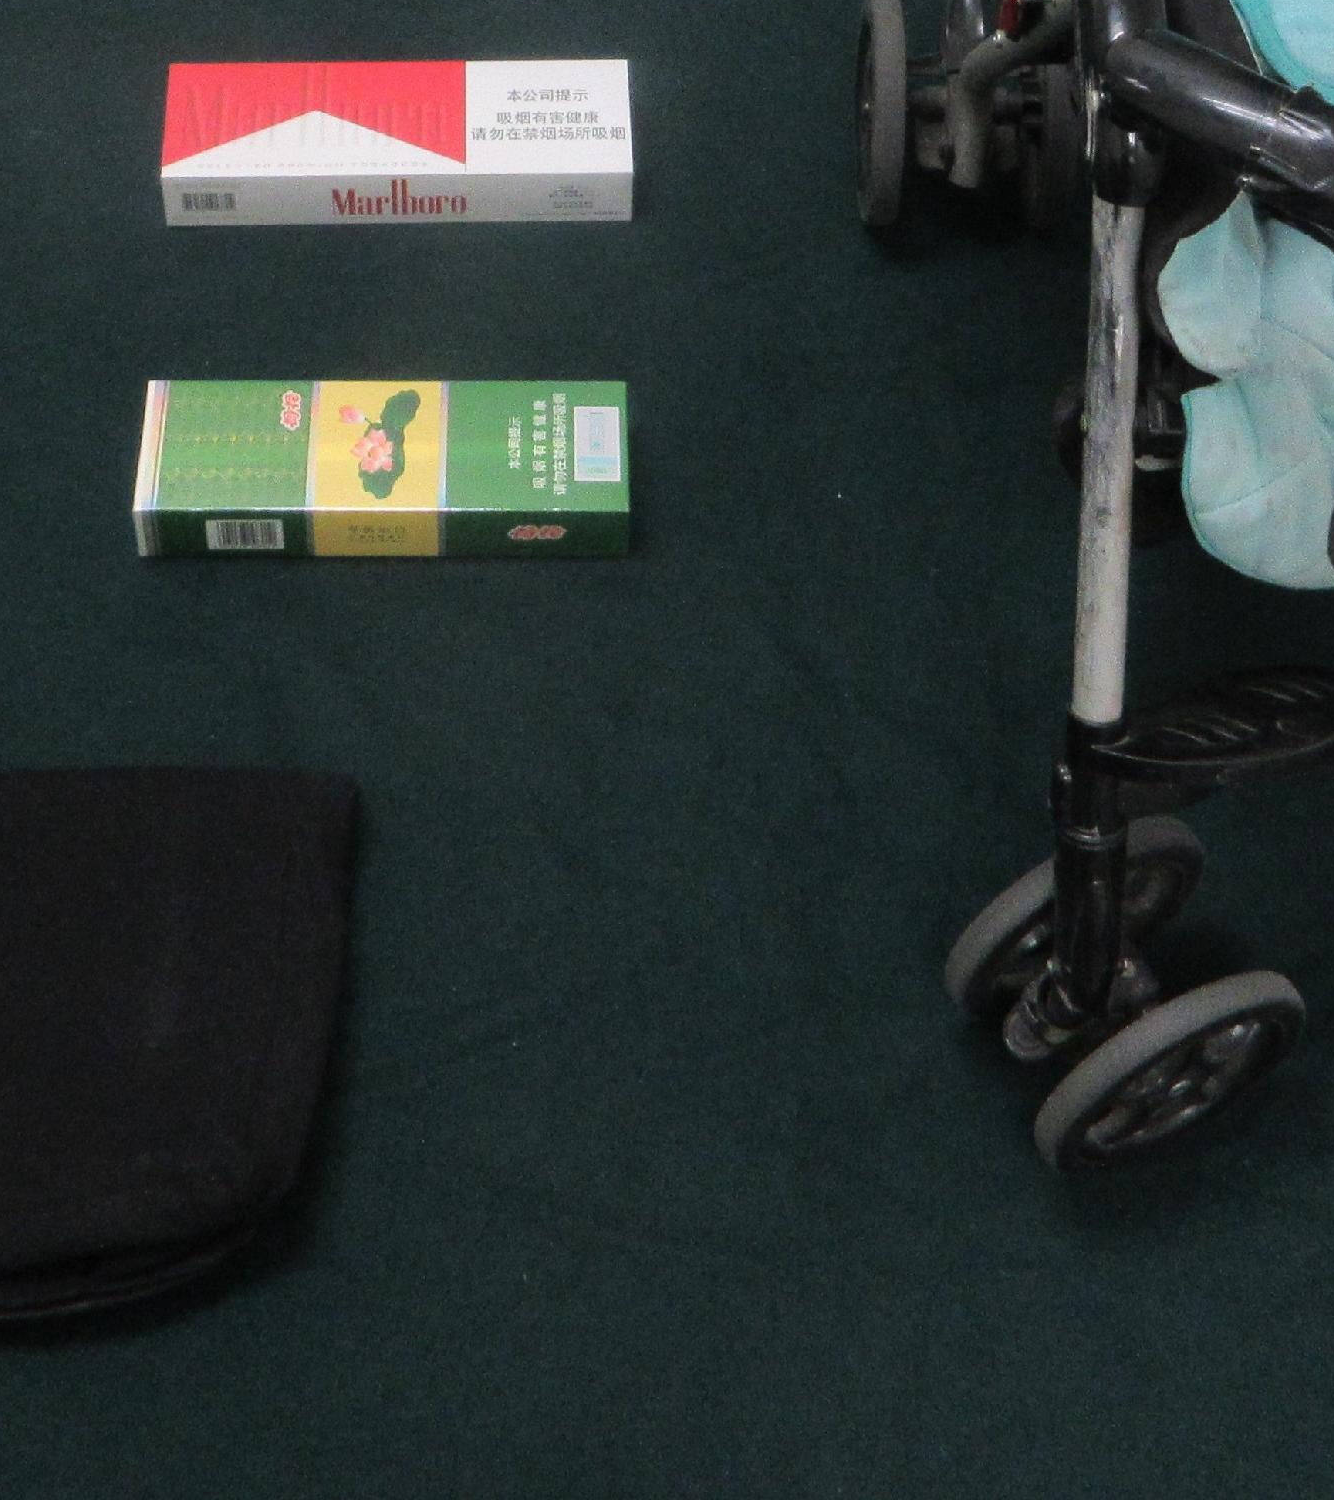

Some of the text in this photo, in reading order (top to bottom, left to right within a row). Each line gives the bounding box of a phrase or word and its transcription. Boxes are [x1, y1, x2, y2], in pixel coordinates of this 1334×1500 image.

[507, 89, 589, 102] 本公司提示
[497, 111, 599, 125] 吸烟有害健康
[471, 126, 626, 141] 请勿在禁烟场所吸烟
[332, 179, 467, 216] Marlboro
